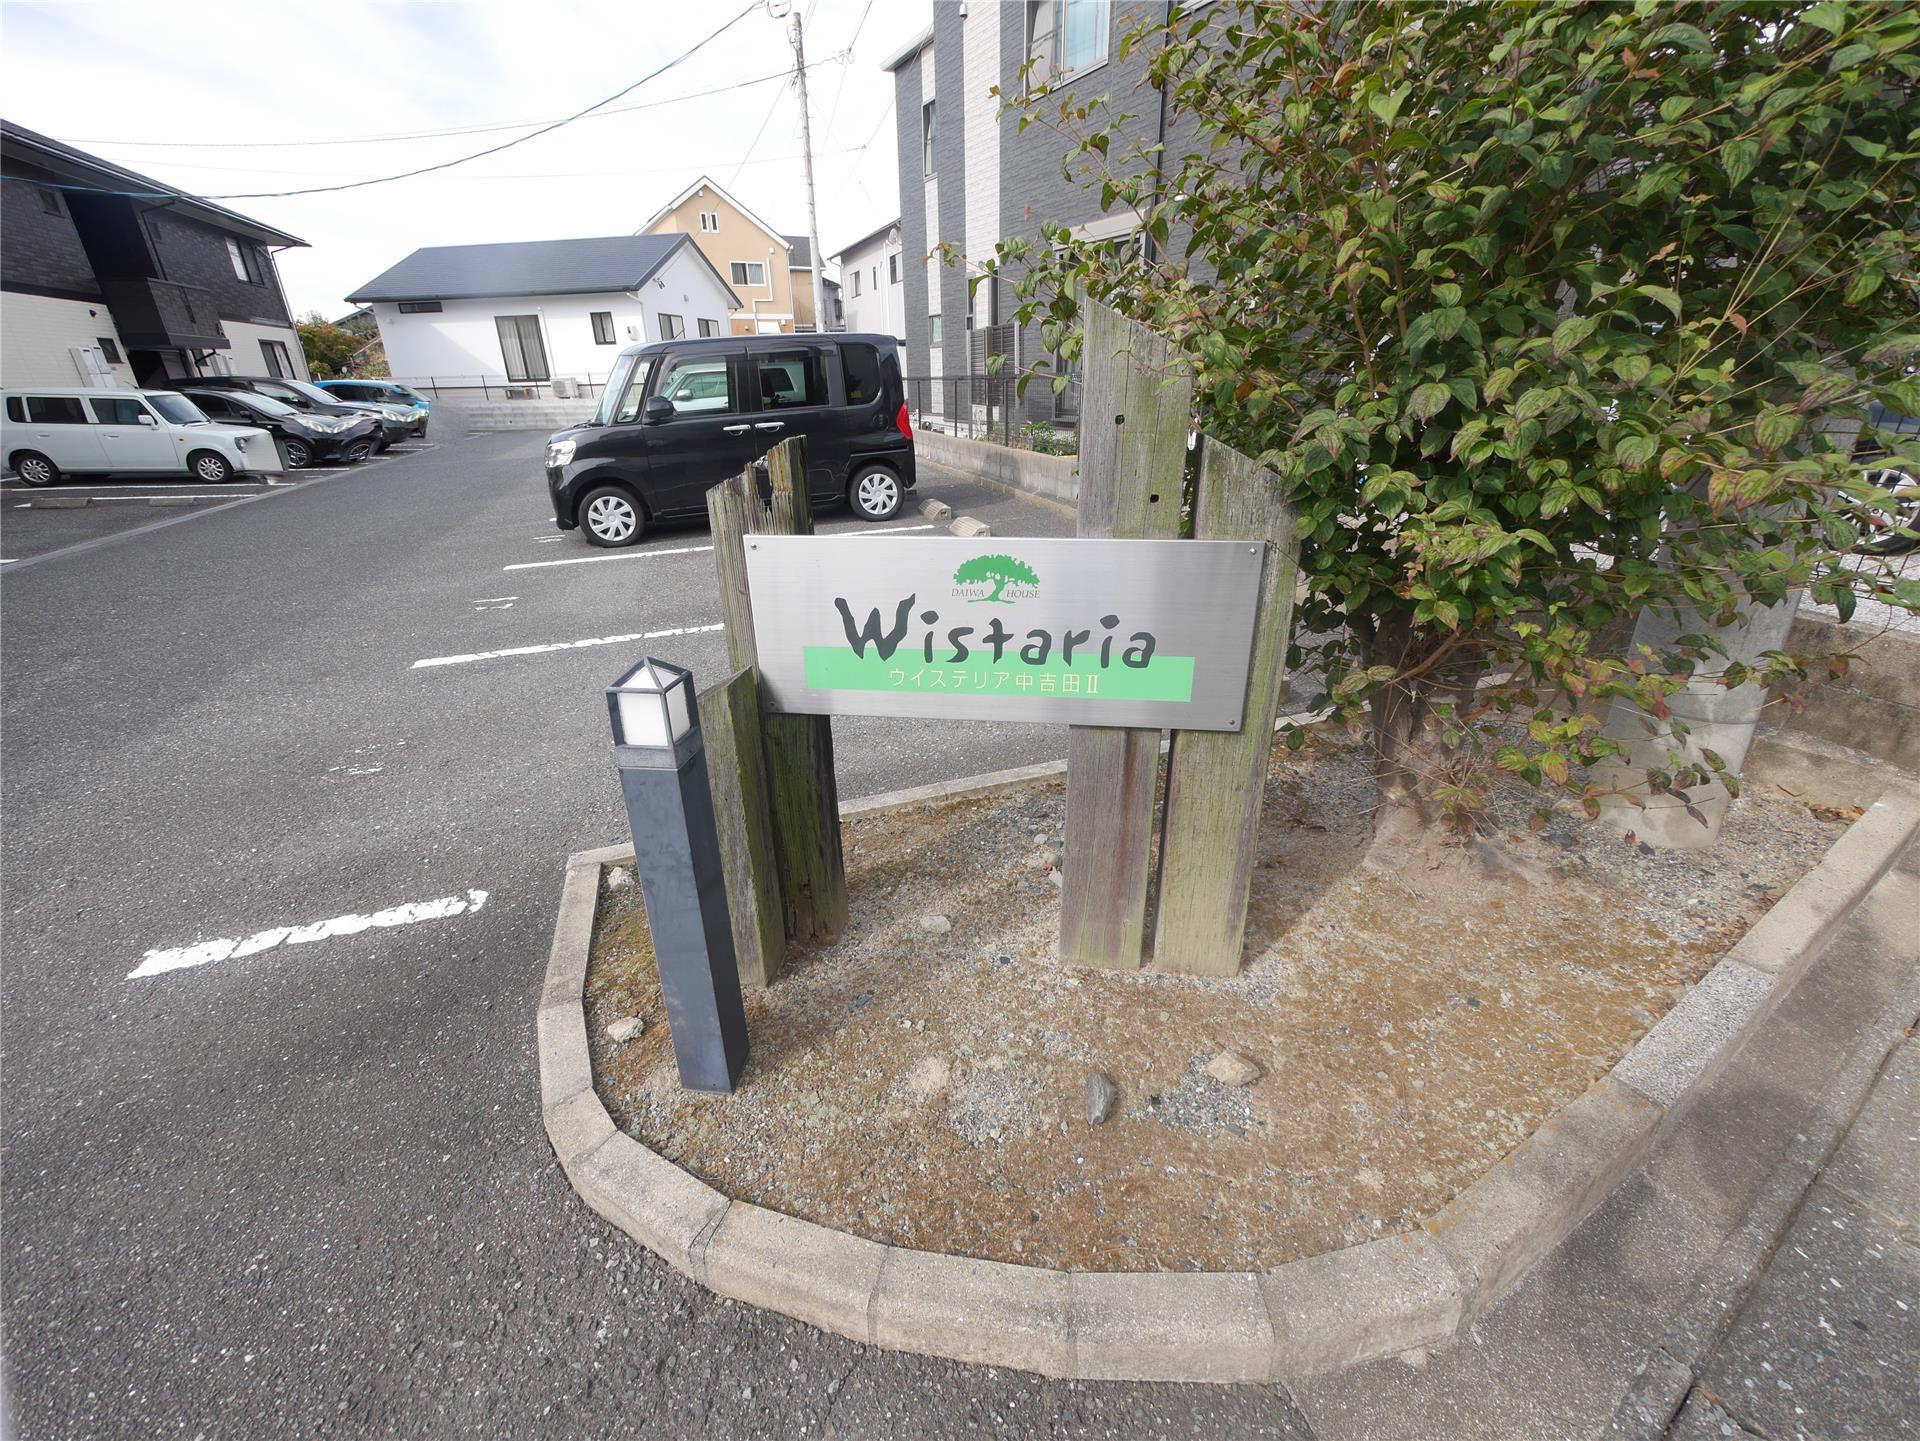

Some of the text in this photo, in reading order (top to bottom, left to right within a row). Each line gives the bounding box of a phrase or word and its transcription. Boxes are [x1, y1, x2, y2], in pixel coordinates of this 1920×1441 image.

[951, 588, 1040, 598] DAIWA HOUSE
[834, 593, 1156, 669] Wistaria
